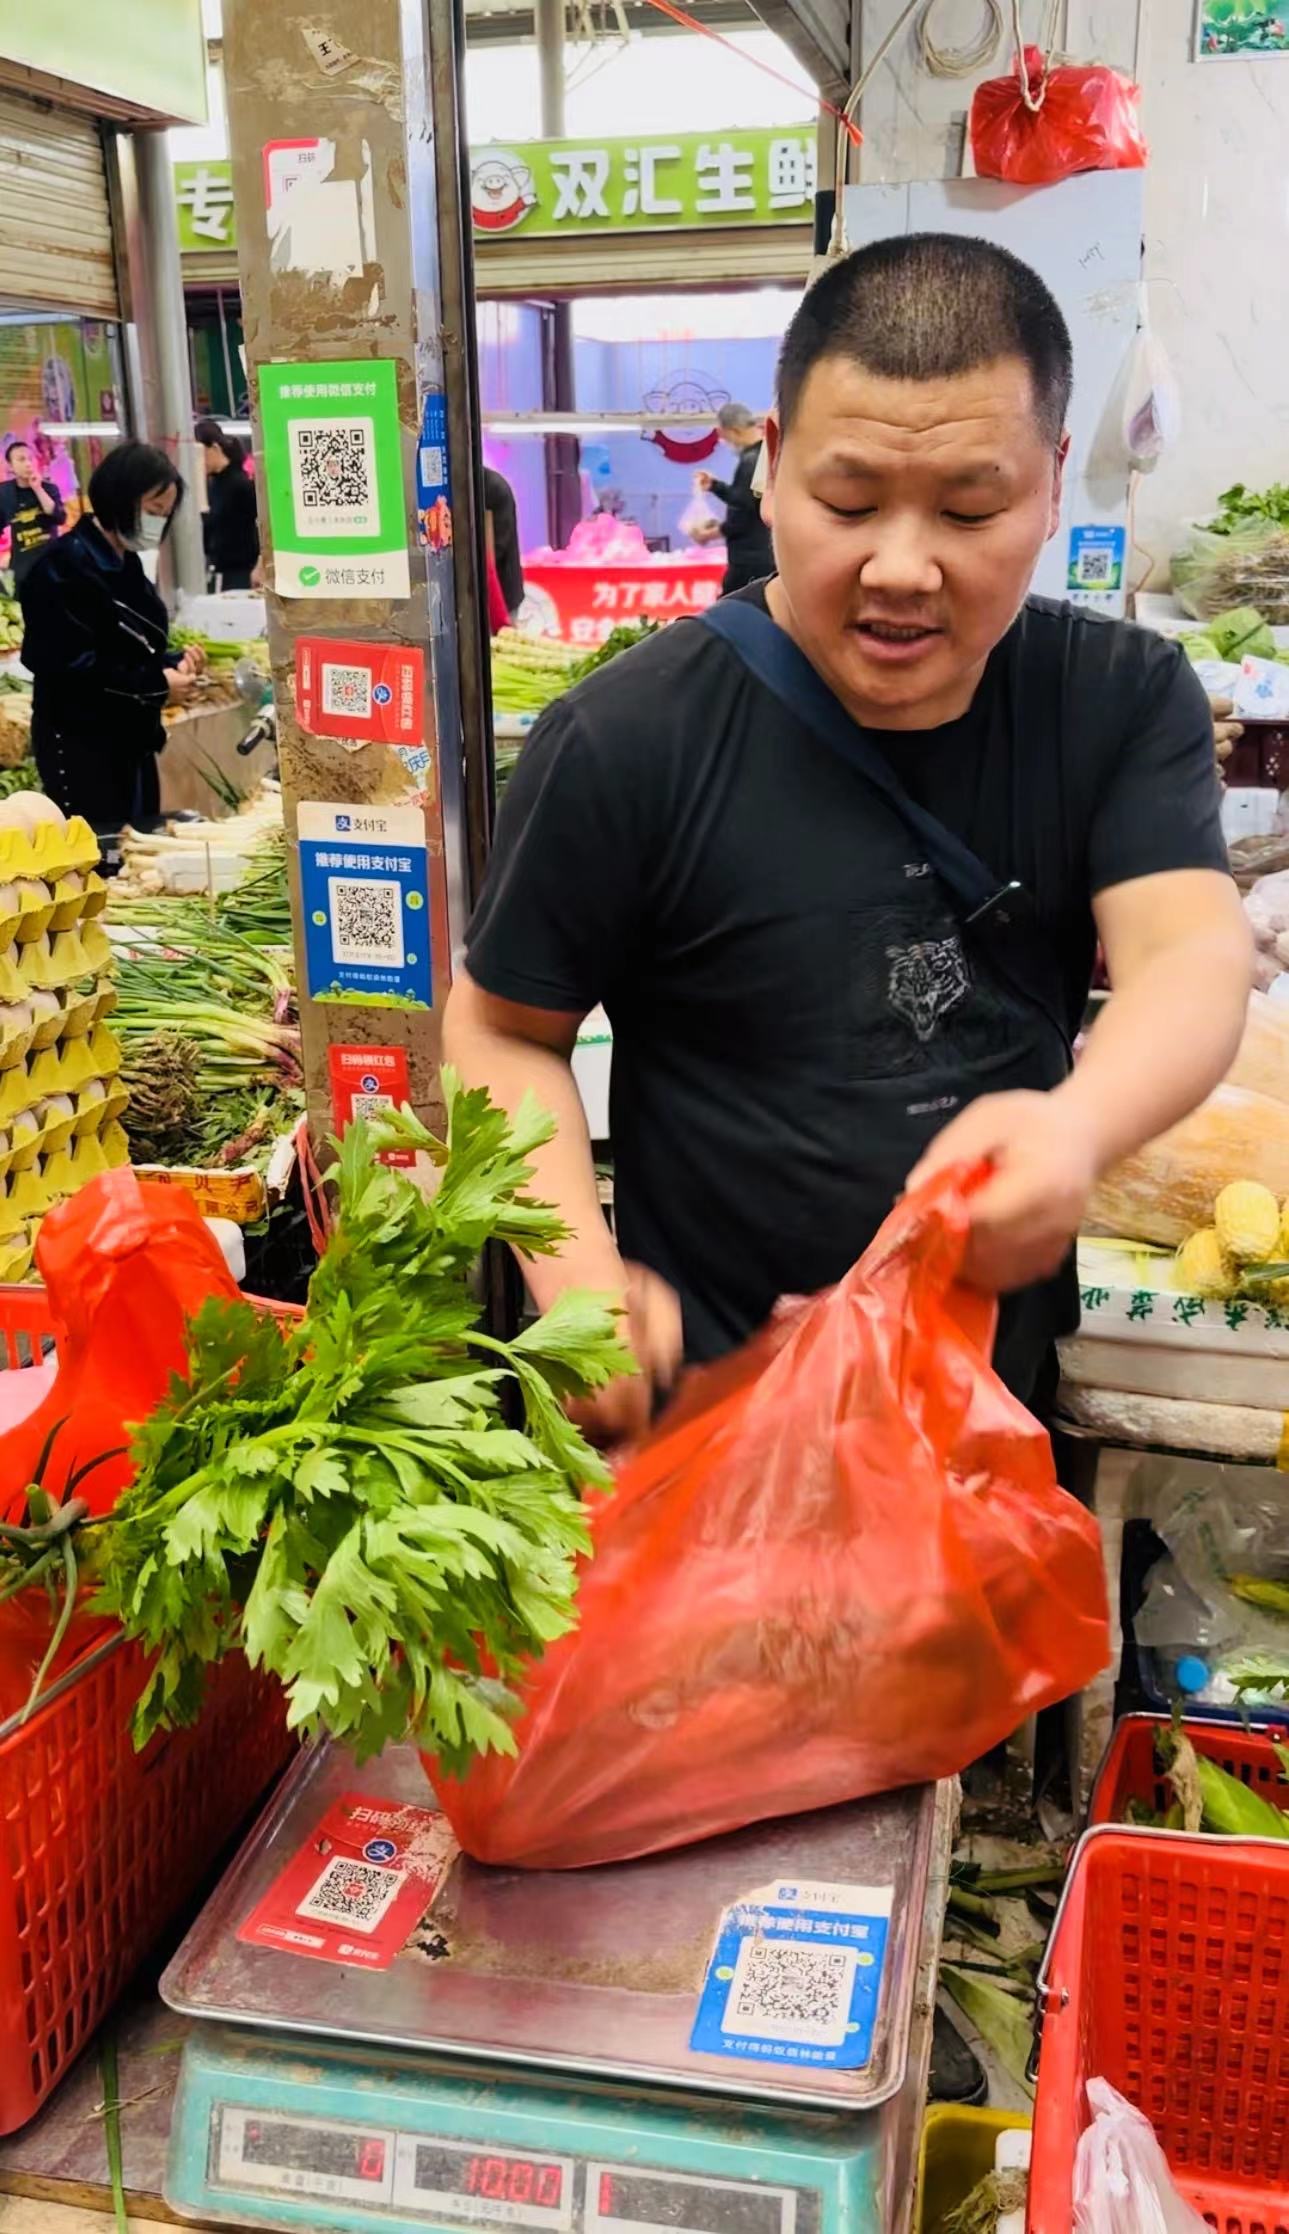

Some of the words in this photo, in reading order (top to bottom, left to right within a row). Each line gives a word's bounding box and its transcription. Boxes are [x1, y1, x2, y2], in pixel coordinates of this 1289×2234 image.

[549, 138, 813, 221] 双汇生鲜
[176, 168, 233, 240] 专
[325, 568, 384, 585] 微信支付
[592, 579, 723, 609] 为了家人健
[353, 818, 387, 833] 支付宝
[315, 852, 412, 873] 推荐使用支付宝
